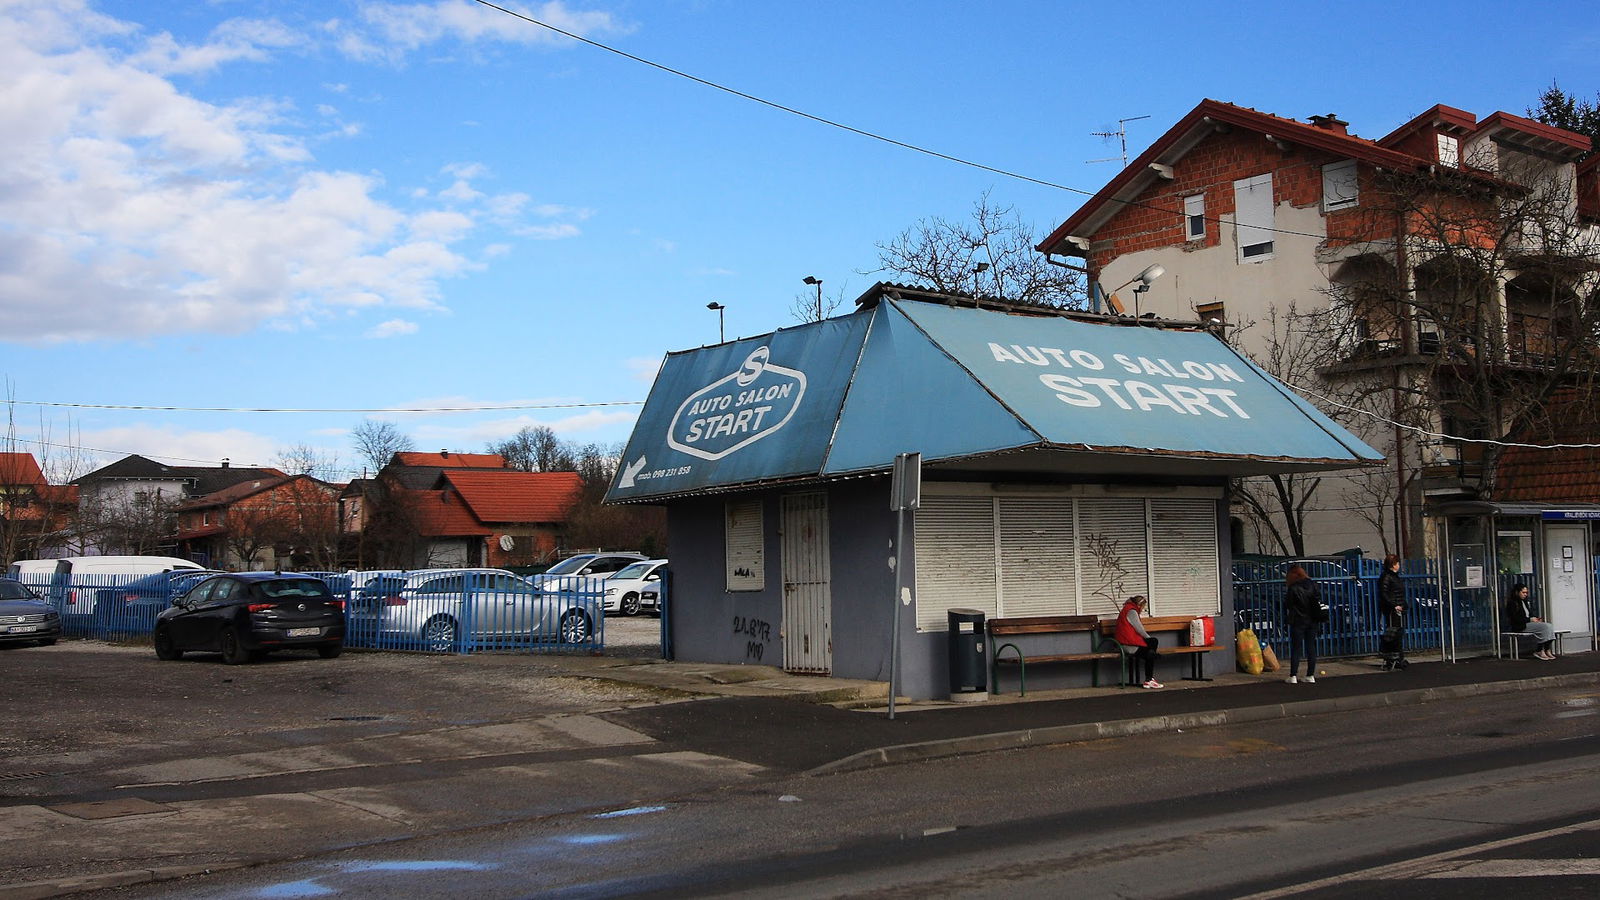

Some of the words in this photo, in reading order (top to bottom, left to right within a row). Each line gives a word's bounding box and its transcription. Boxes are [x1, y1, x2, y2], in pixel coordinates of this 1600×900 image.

[740, 348, 767, 384] S
[987, 342, 1104, 370] AUTO
[1112, 353, 1245, 383] SALON
[688, 394, 732, 415] AUTO
[735, 382, 794, 407] SALON
[1039, 373, 1251, 419] START
[686, 406, 773, 443] START
